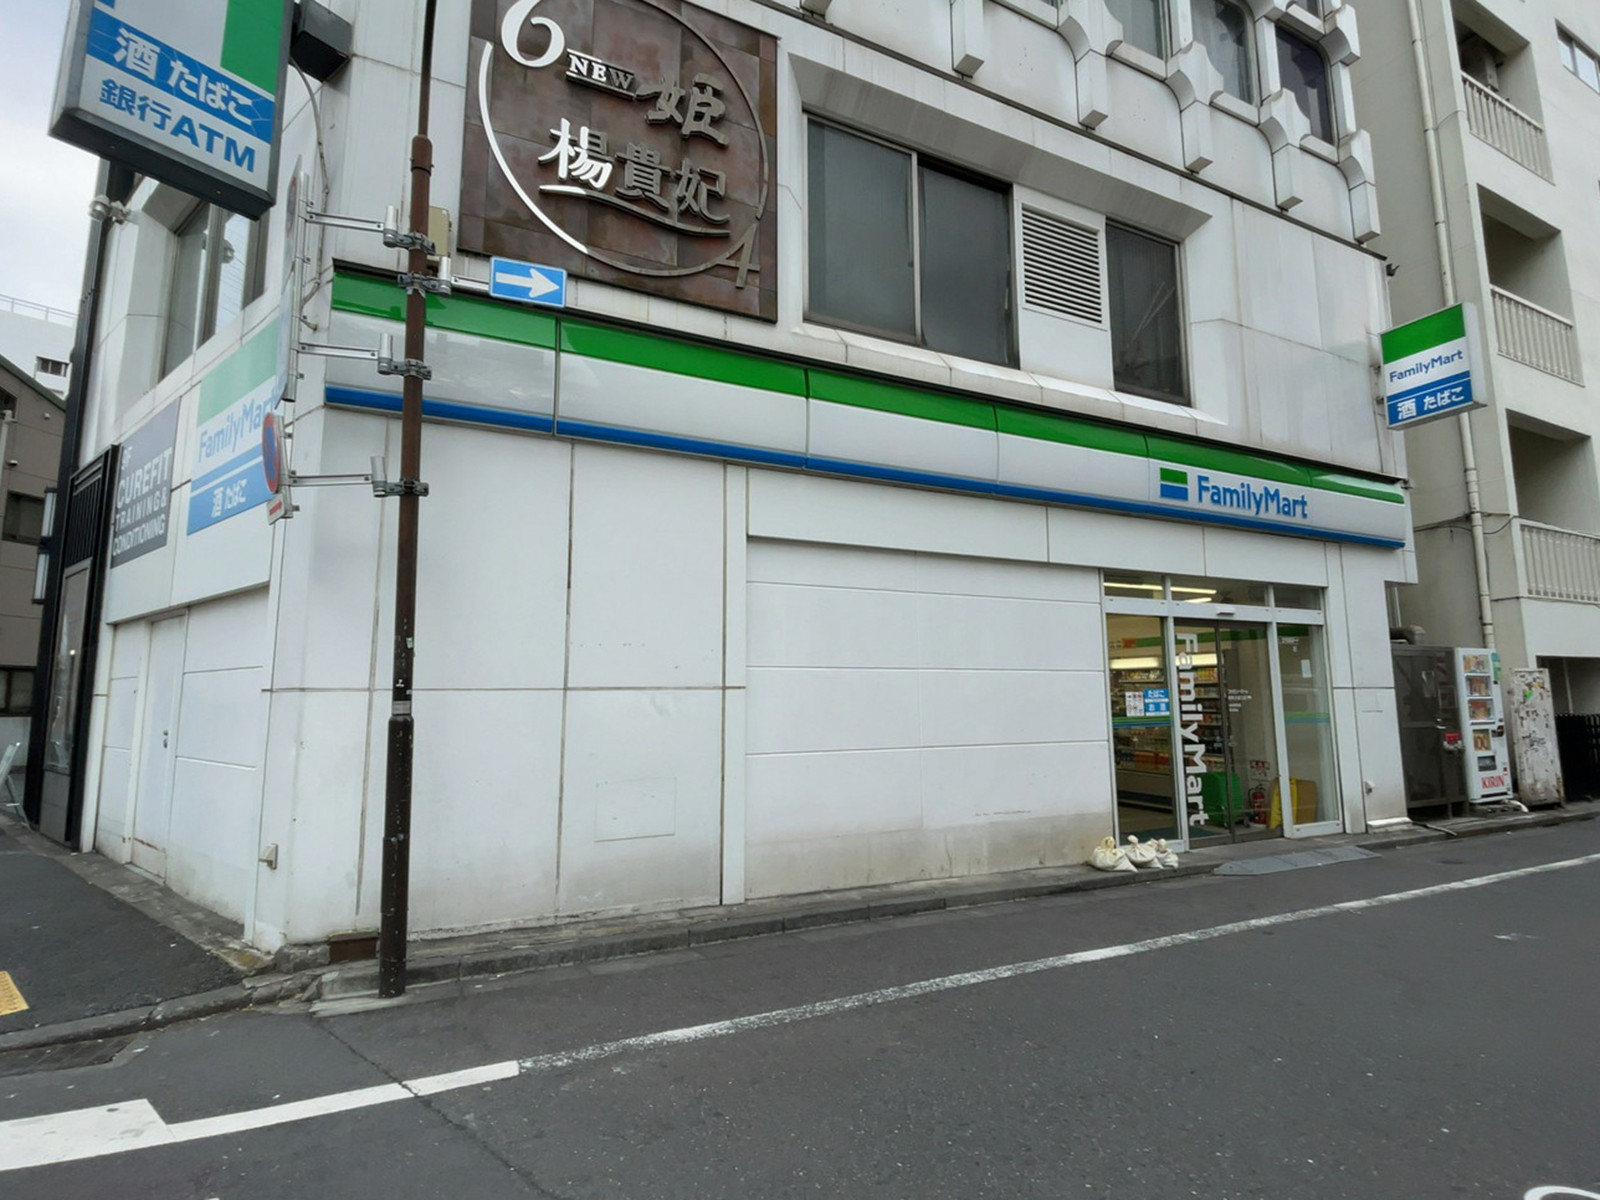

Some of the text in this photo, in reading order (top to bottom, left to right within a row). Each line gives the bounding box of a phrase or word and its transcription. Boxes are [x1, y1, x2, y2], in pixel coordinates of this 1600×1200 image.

[501, 0, 566, 68] 6
[113, 27, 254, 127] 酒 たばこ
[568, 54, 635, 91] NEW
[99, 78, 257, 174] 銀行ATM
[537, 117, 732, 226] 楊貴妃
[1388, 349, 1464, 383] FamilyMart
[1396, 386, 1466, 421] 酒 たばこ
[116, 446, 173, 510] CUREFIT
[1197, 474, 1309, 520] FamilyMart
[1175, 632, 1211, 828] FamilyMart
[1481, 775, 1505, 790] KIRIN
